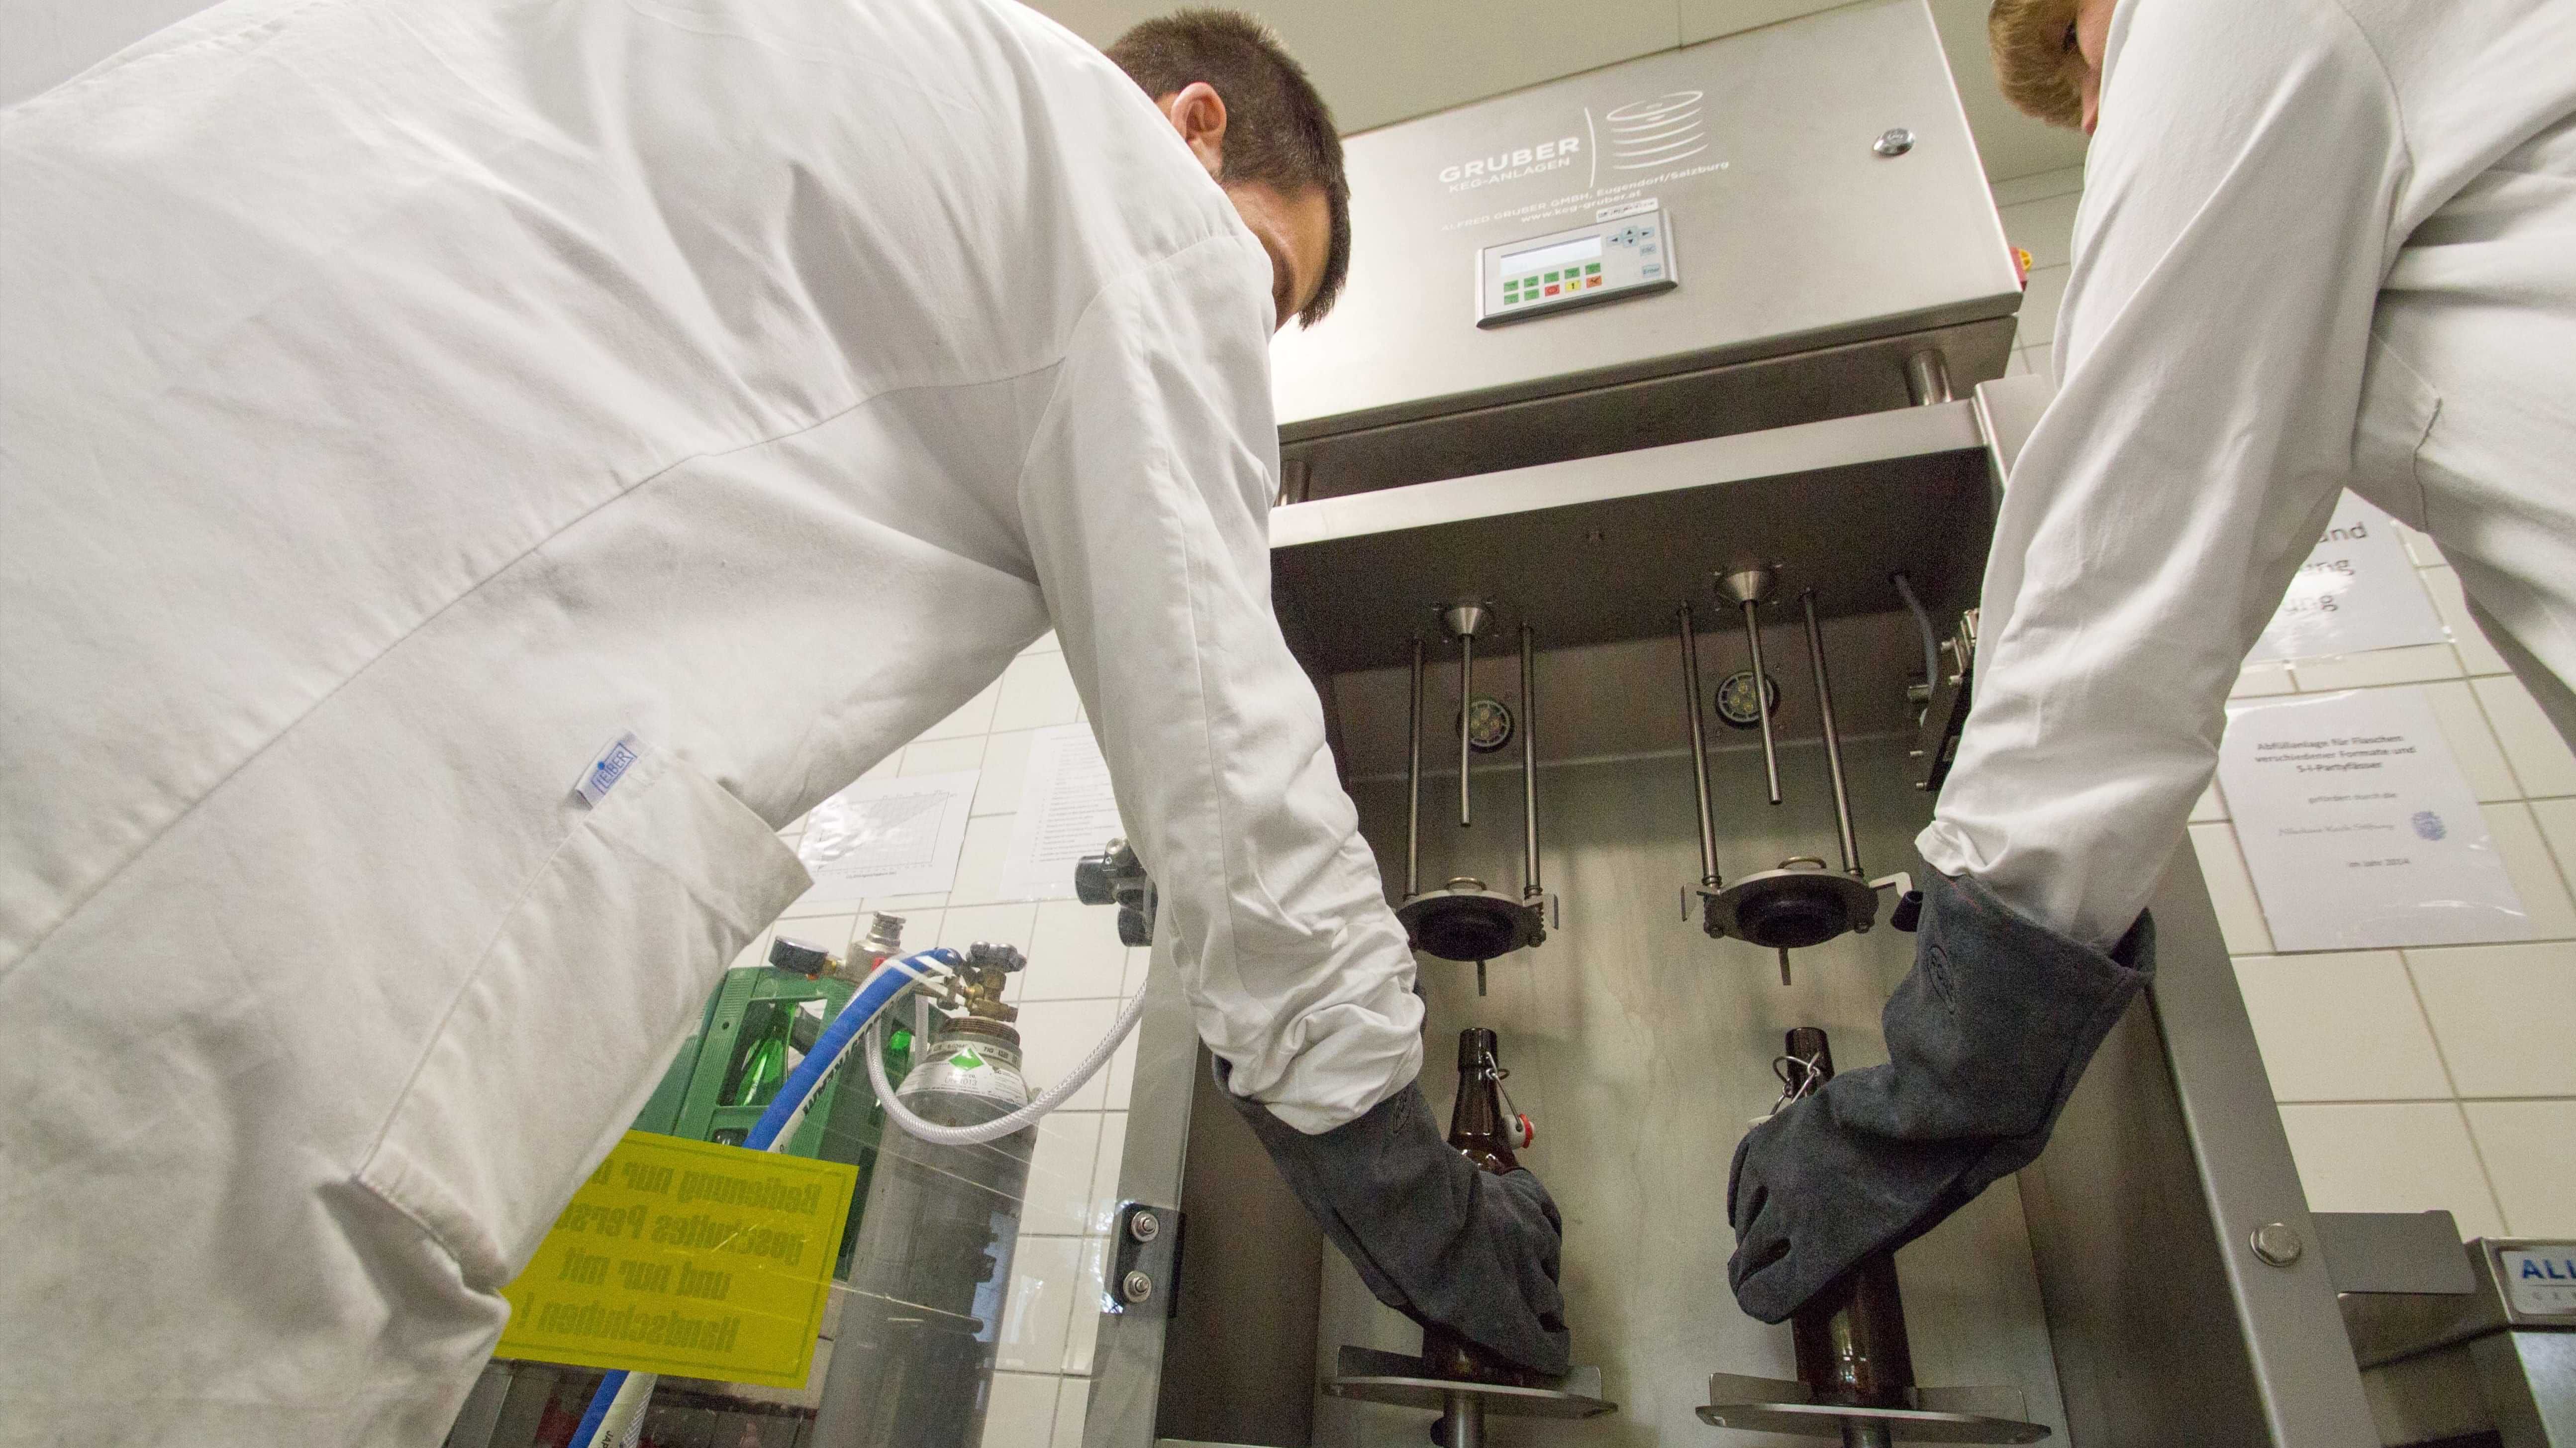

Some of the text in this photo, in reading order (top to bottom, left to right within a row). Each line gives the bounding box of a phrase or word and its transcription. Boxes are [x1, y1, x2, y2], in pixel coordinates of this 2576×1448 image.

[1439, 137, 1579, 182] GRUBER
[1449, 157, 1570, 193] KEG-ANLAGEN
[1441, 161, 1729, 231] ALFRED GRUBER GMBH, Eugendorf/Salzburg
[1521, 189, 1642, 223] www.keg-gruber.at
